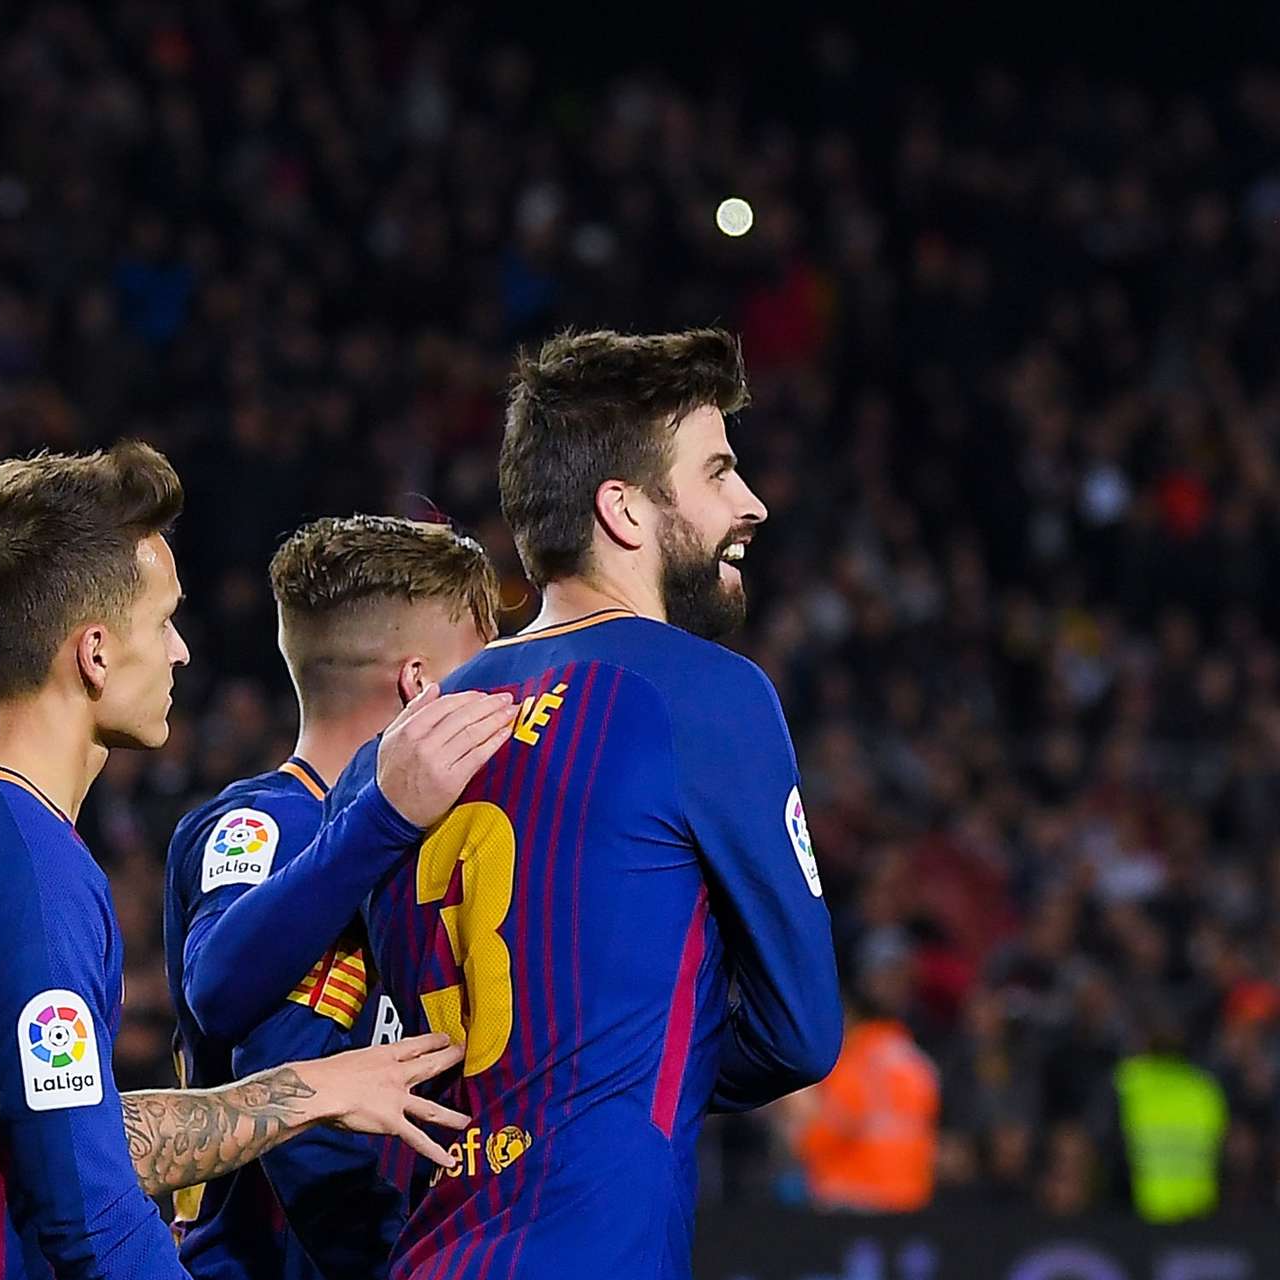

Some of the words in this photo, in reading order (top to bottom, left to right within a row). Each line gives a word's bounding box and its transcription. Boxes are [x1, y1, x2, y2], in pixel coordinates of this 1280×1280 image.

[209, 859, 261, 878] LaLiga
[417, 801, 516, 1078] 3
[33, 1071, 95, 1093] LaLiga
